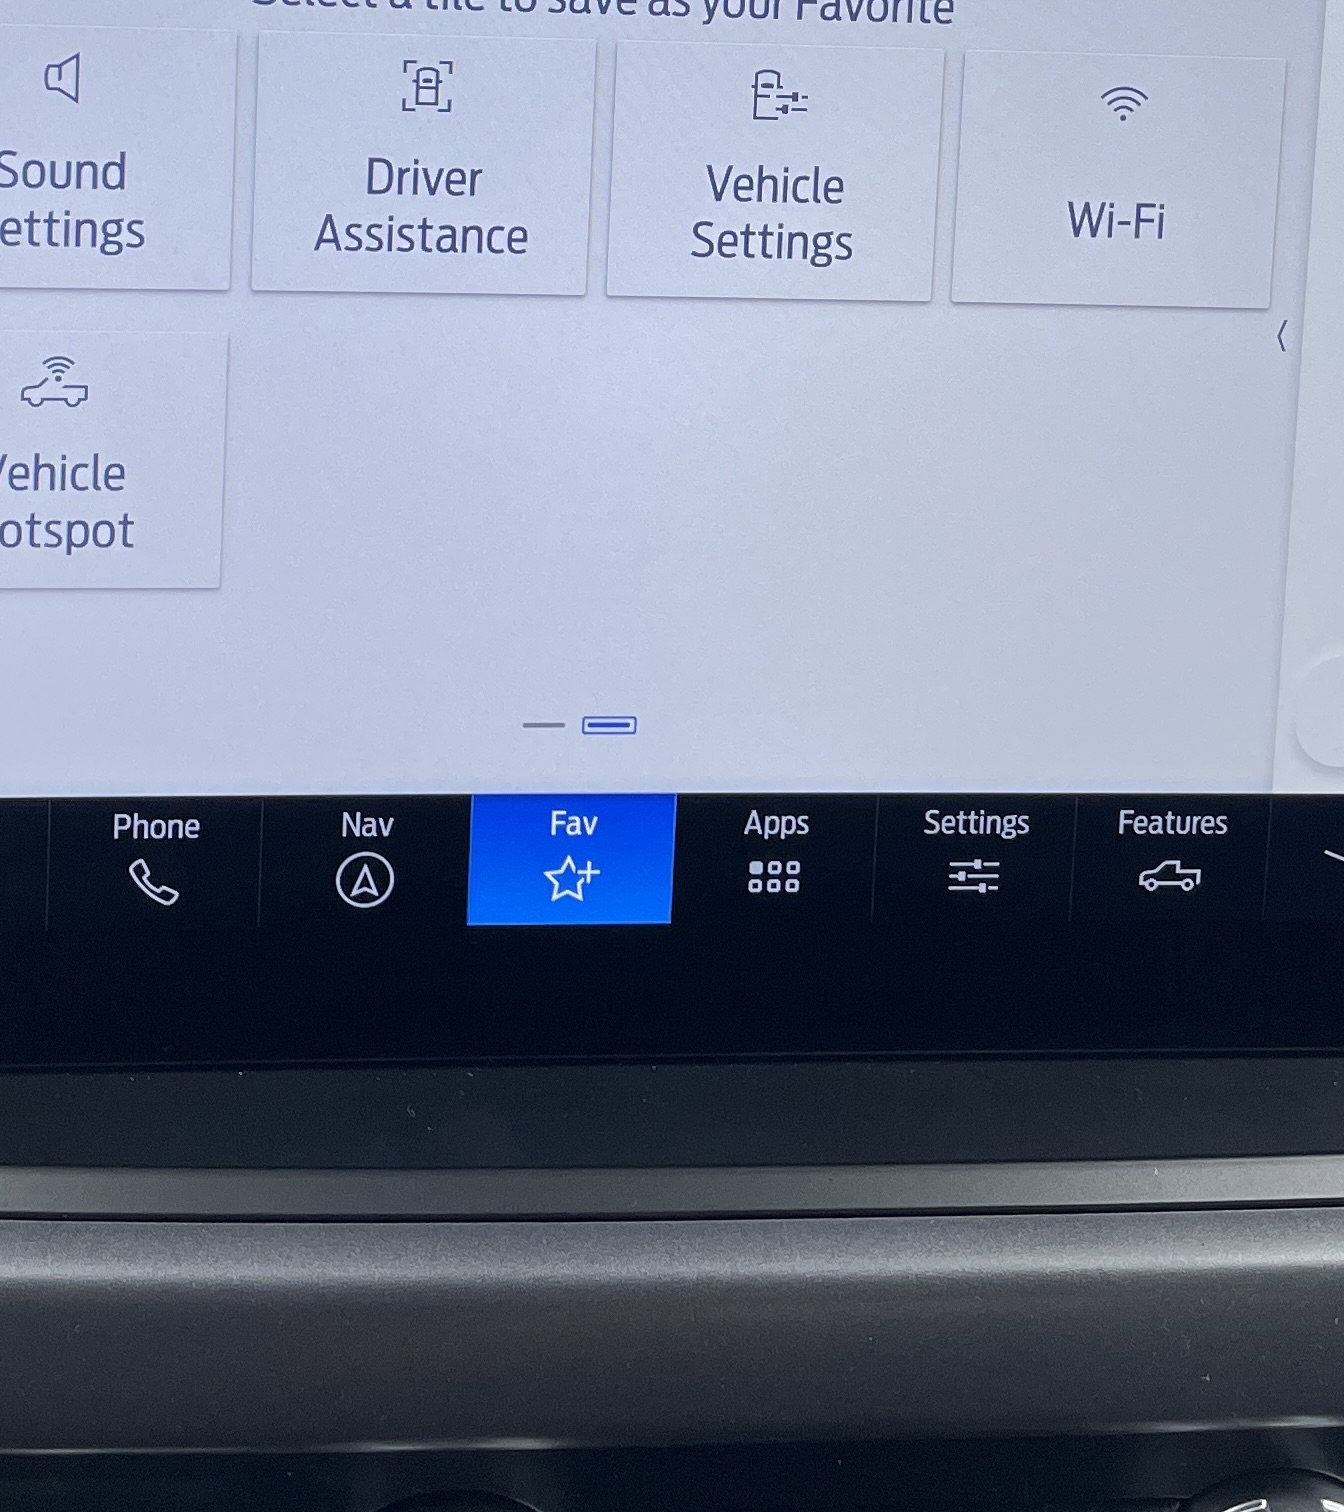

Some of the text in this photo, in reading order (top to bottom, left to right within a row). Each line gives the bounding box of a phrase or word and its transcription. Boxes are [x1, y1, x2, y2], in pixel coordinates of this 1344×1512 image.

[368, 158, 482, 196] Driver
[707, 165, 843, 204] Vehicle
[314, 214, 527, 254] Assistance
[1068, 201, 1164, 239] Wi-Fi
[691, 221, 852, 267] Settings
[114, 813, 200, 839] Phone
[342, 812, 394, 837] Nav
[550, 811, 598, 836] Fav
[744, 810, 809, 839] Apps
[924, 810, 1029, 839] Settings
[1119, 810, 1227, 834] Features
